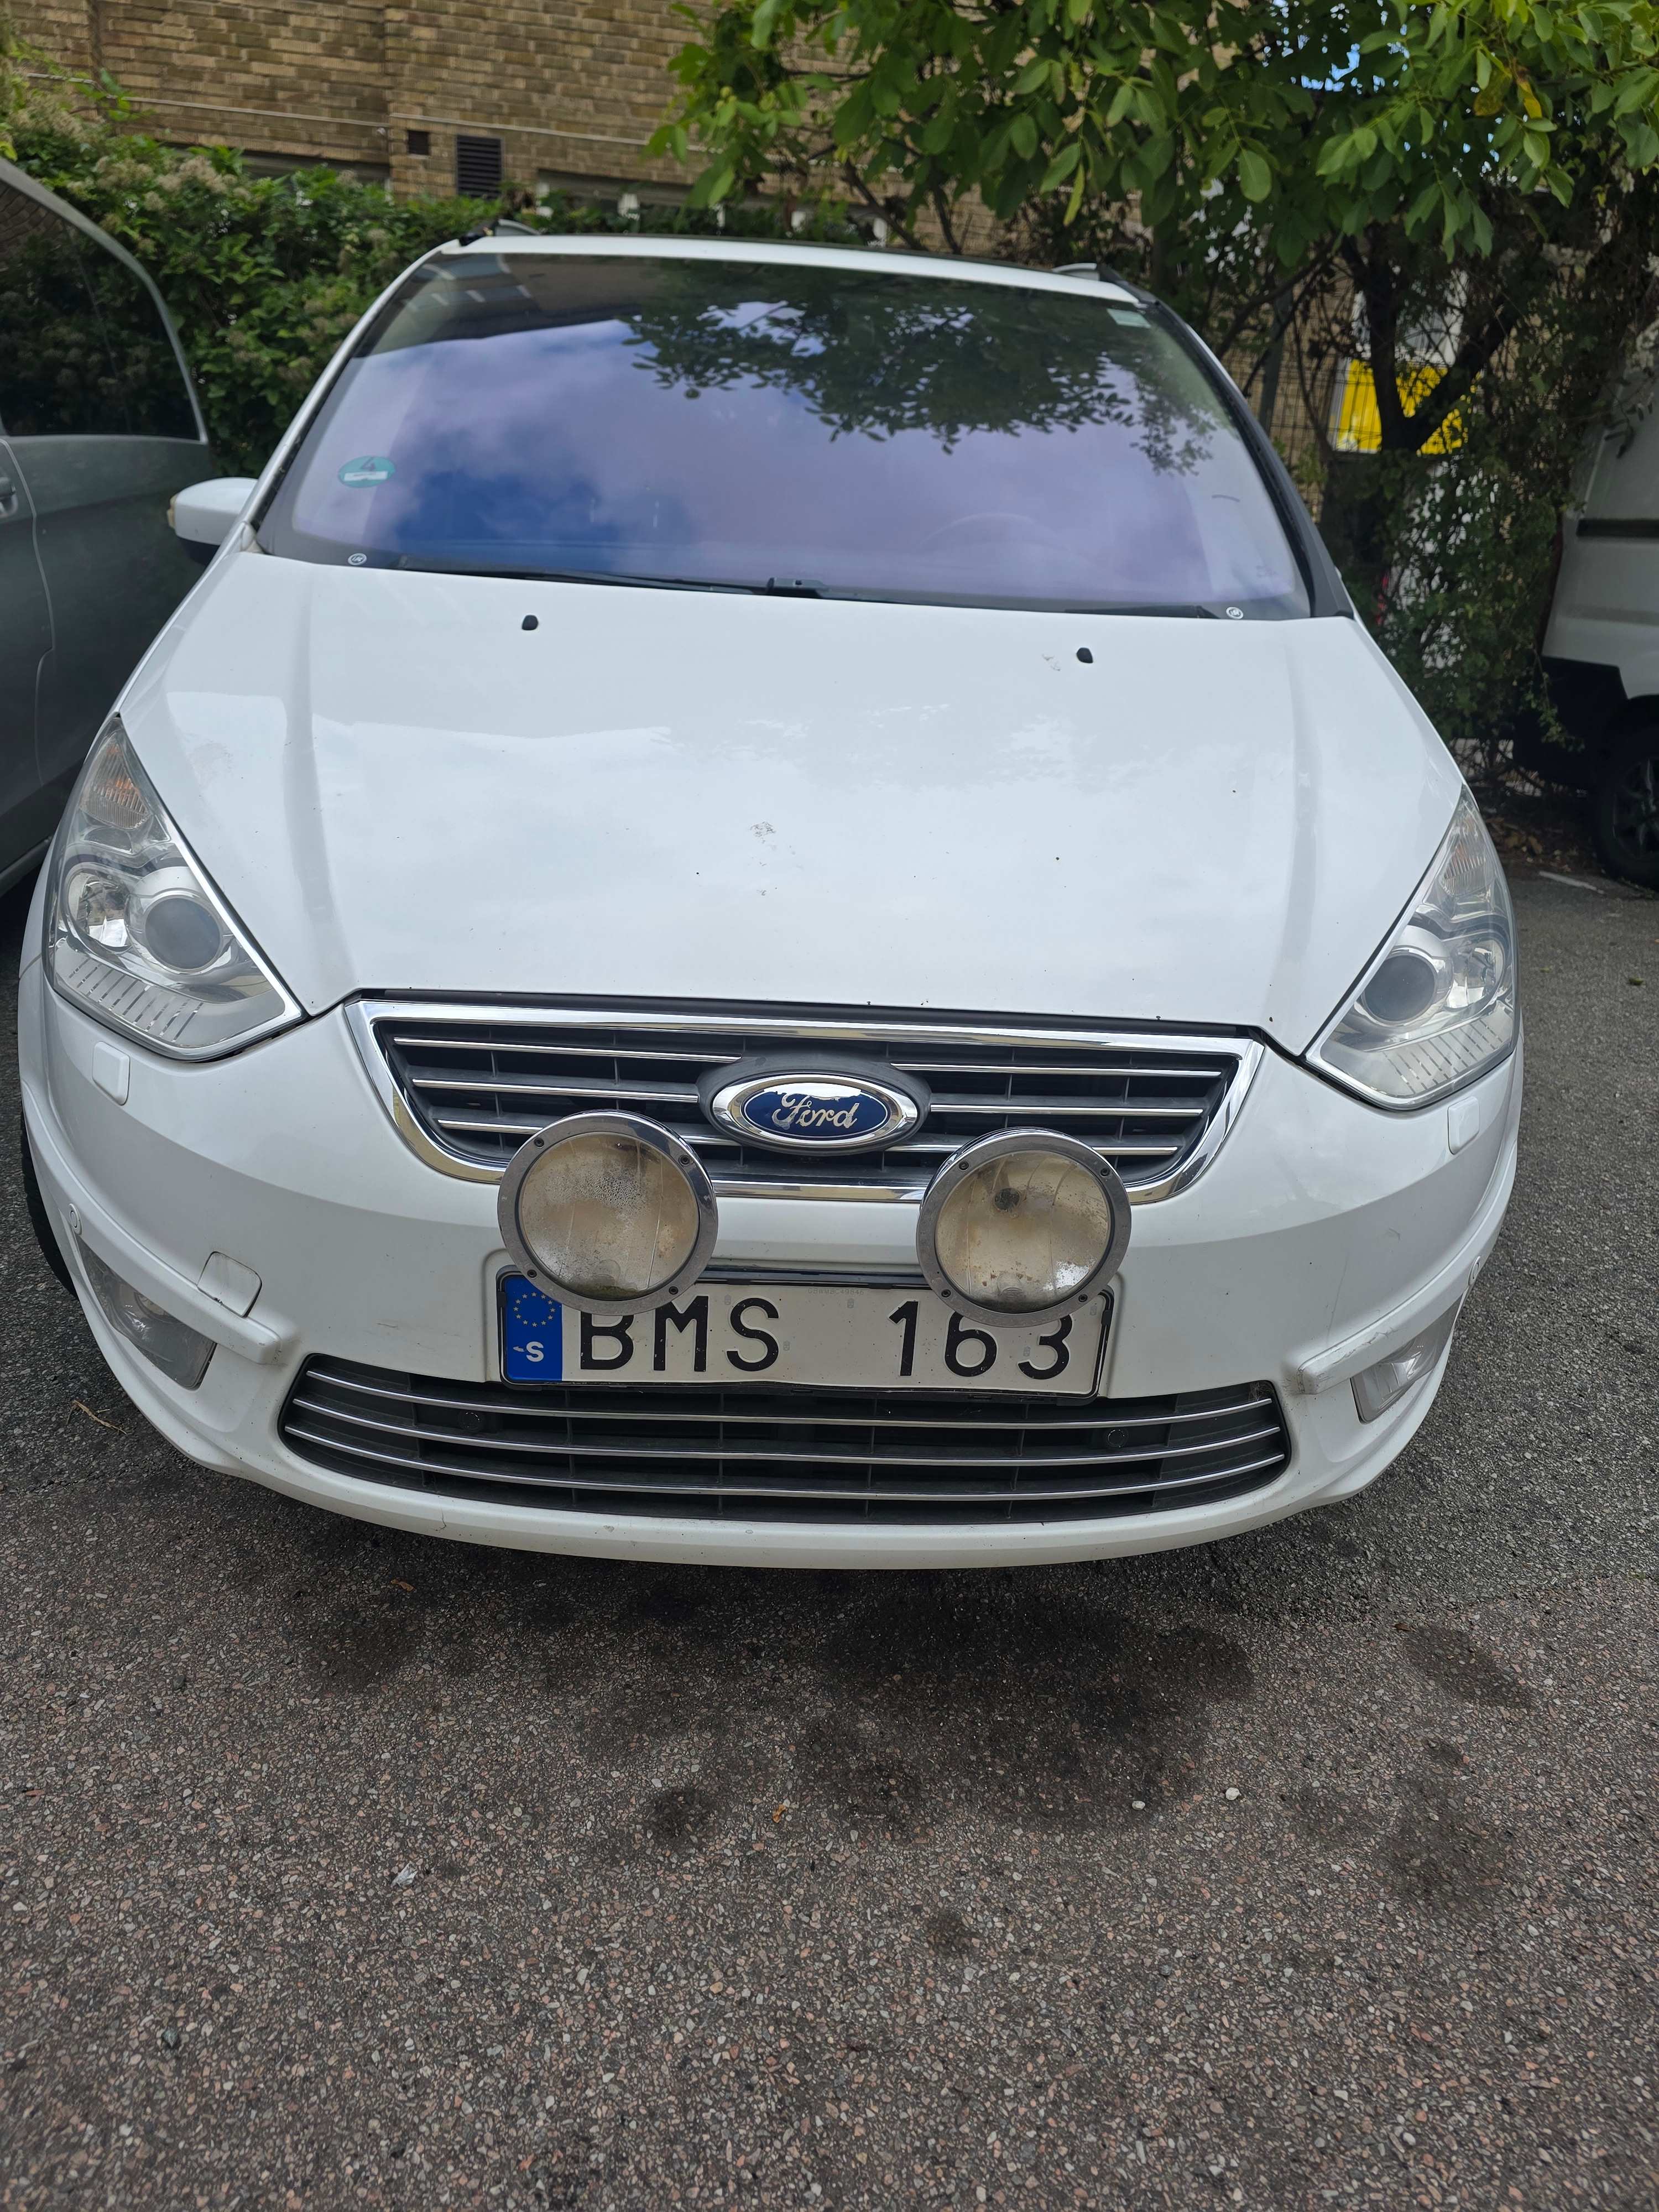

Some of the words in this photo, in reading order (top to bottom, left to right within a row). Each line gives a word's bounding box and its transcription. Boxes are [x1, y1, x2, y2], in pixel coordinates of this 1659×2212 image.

[359, 457, 376, 472] 4
[771, 1093, 860, 1130] Ford
[526, 1341, 544, 1362] S
[581, 1296, 779, 1372] BMS
[889, 1301, 1073, 1380] 163
